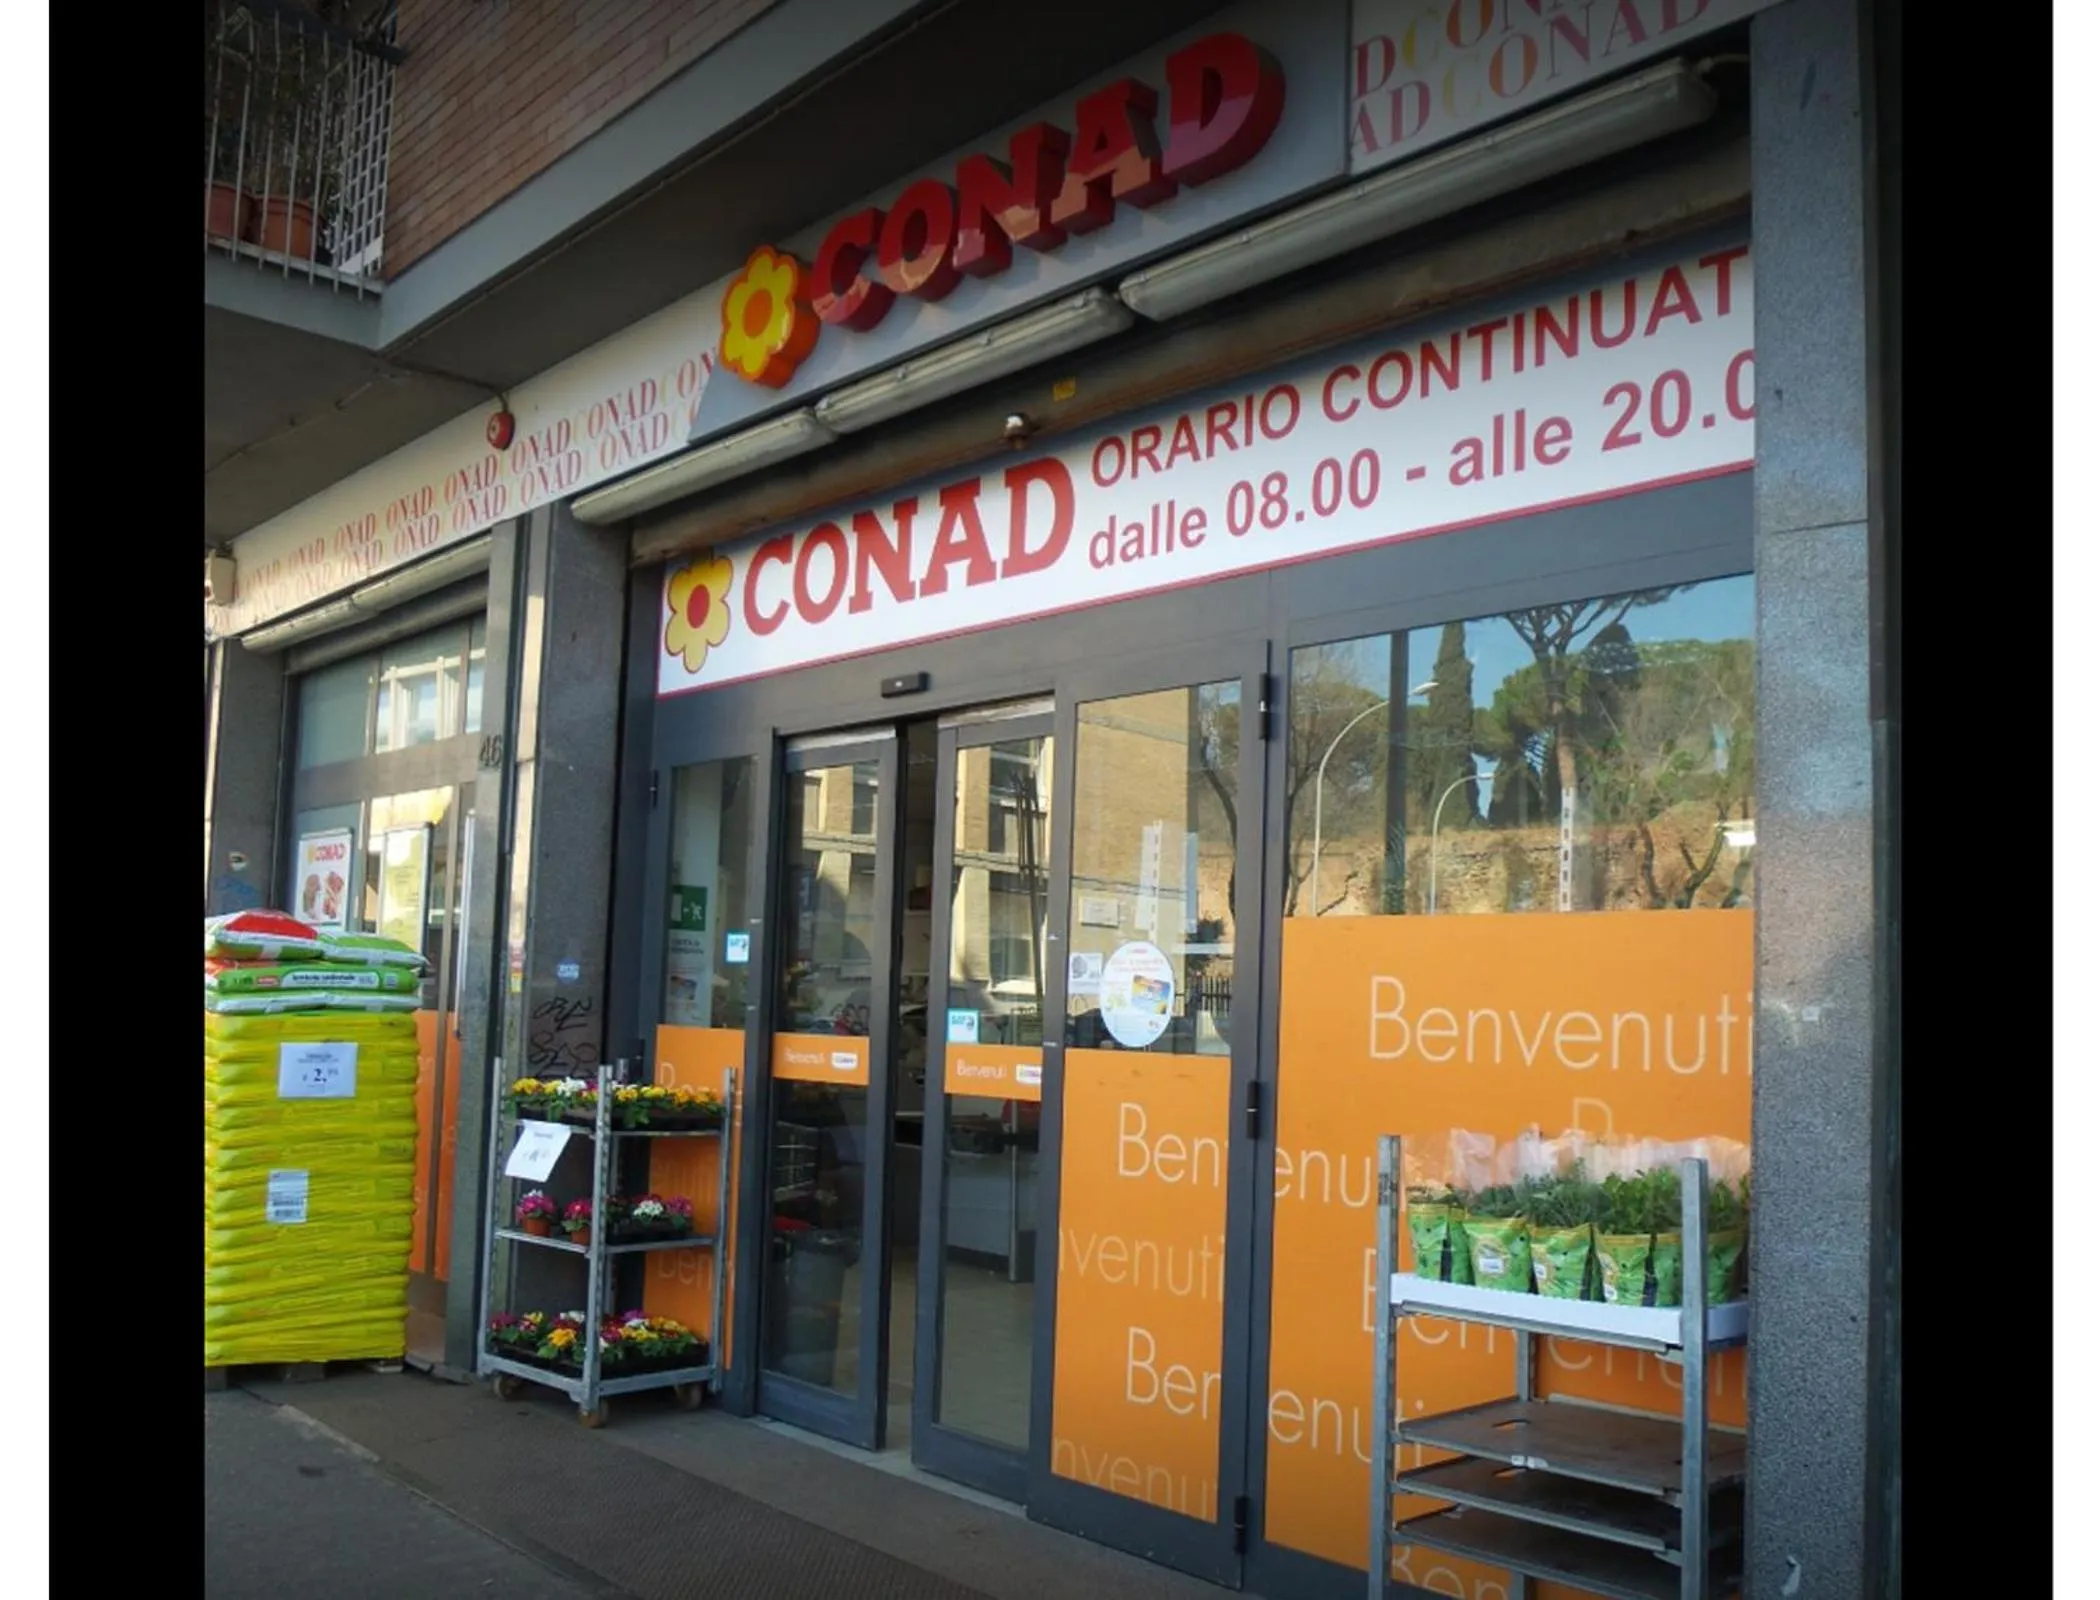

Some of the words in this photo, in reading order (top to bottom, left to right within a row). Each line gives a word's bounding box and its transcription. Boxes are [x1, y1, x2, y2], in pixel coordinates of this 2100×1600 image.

[810, 31, 1286, 333] CONAD
[1087, 501, 1208, 570] dalle
[1225, 447, 1382, 538] 08.00
[1448, 408, 1574, 488] alle
[1090, 383, 1301, 489] ORARIO
[742, 456, 1076, 637] CONAD
[479, 734, 503, 767] 46
[1369, 974, 1754, 1078] Benvenuti
[1059, 1229, 1225, 1302] venuti
